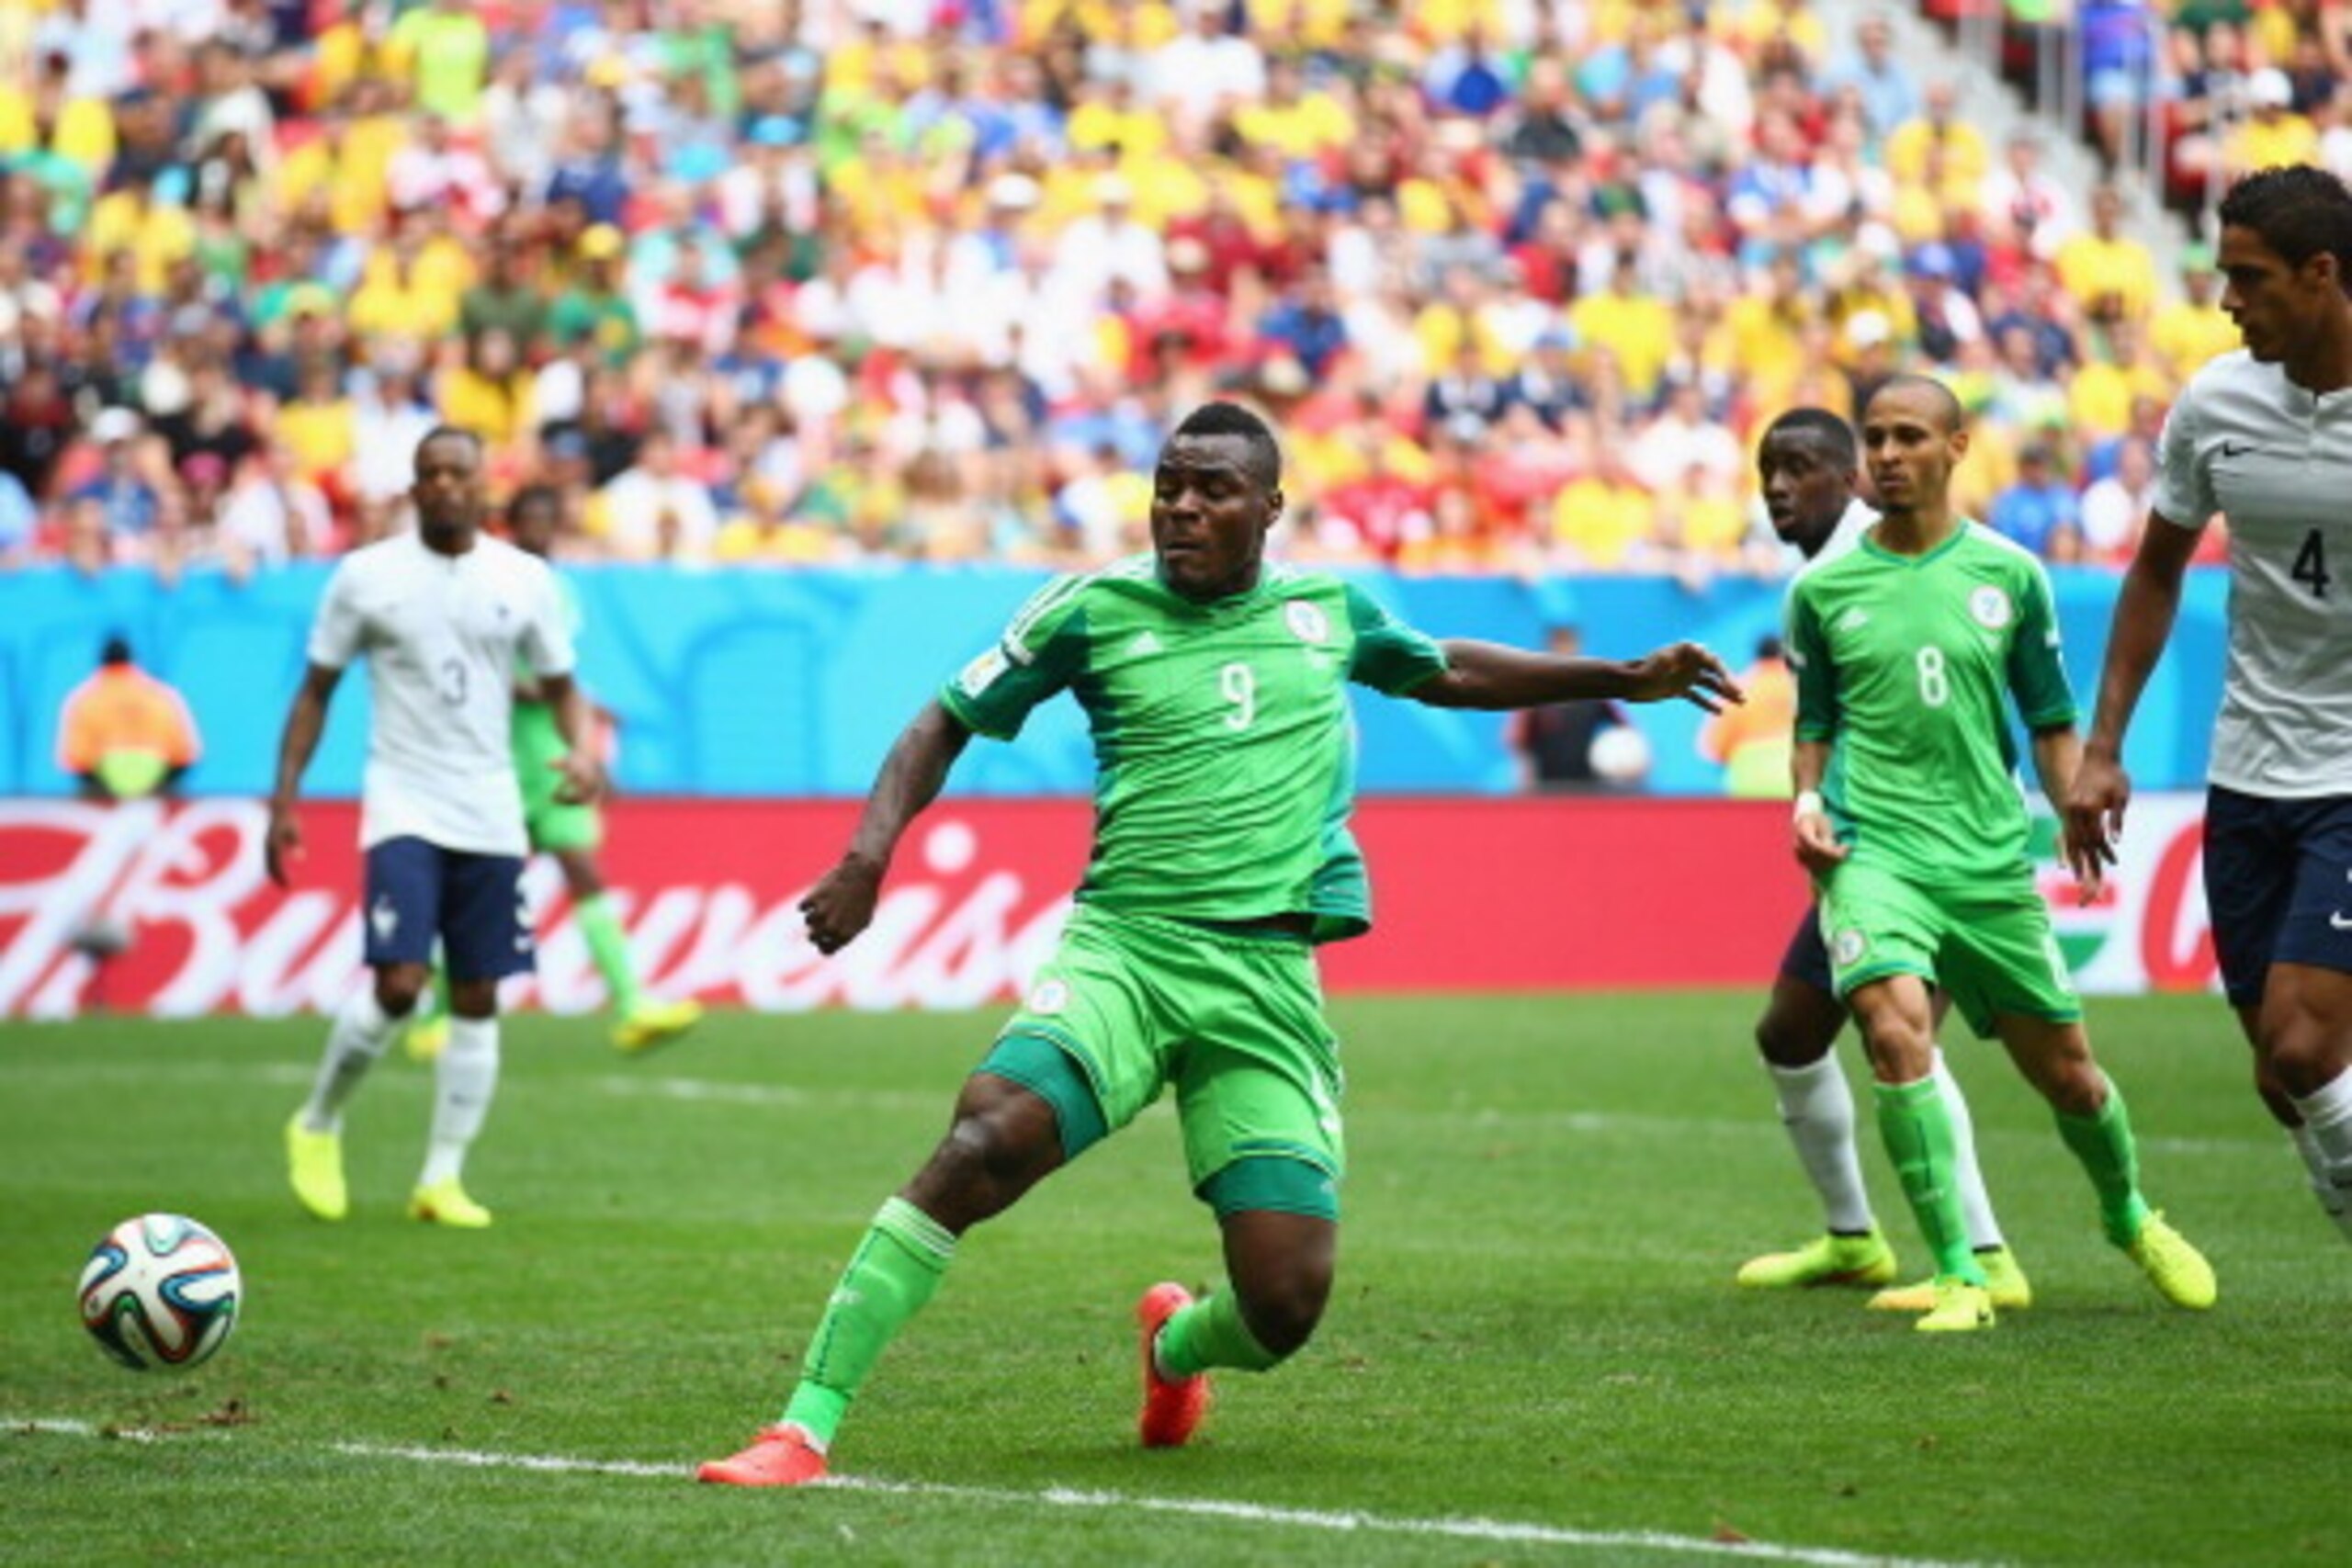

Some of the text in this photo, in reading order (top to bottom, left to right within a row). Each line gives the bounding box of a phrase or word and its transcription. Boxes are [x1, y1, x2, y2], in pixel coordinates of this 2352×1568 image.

[2290, 526, 2331, 598] 4
[440, 656, 469, 707] 3
[1220, 663, 1256, 731] 9
[1917, 645, 1950, 707] 8
